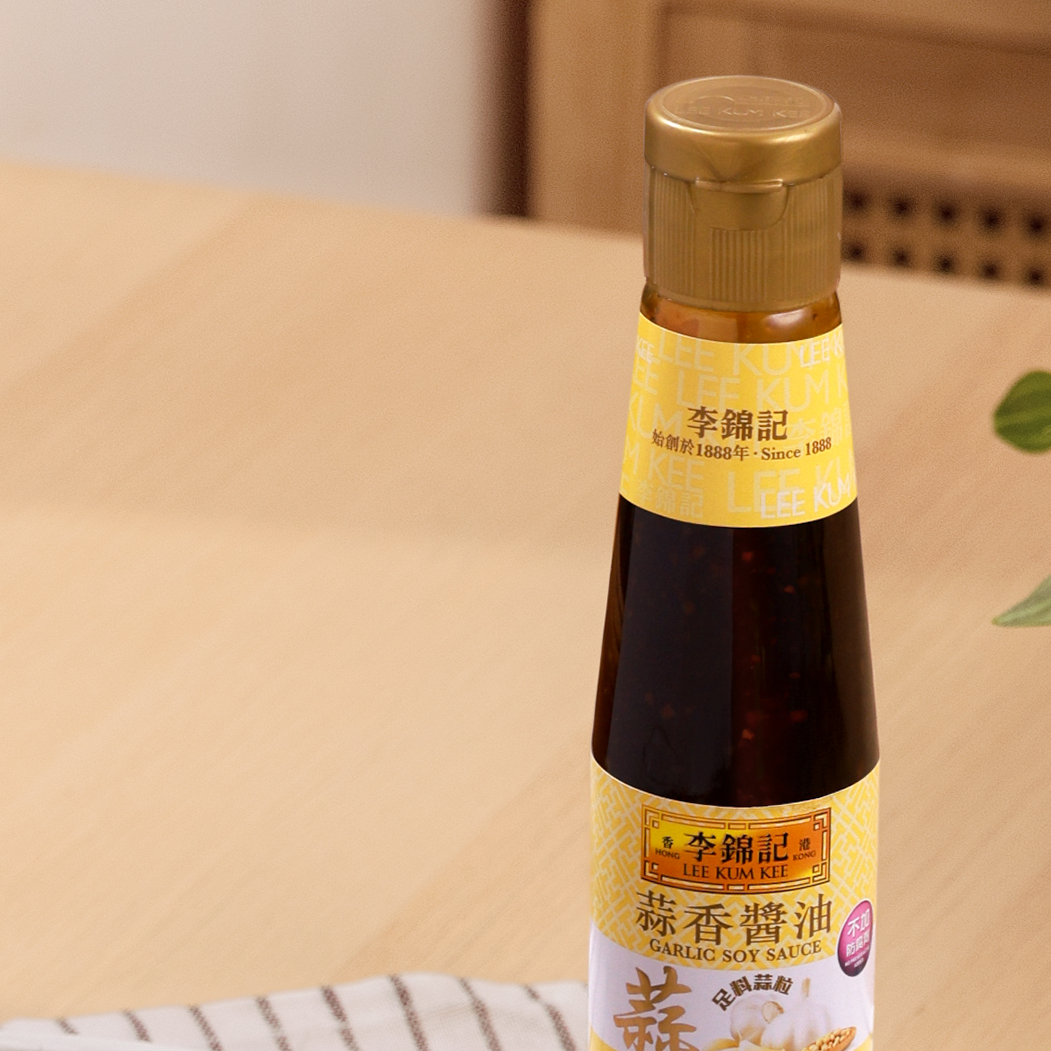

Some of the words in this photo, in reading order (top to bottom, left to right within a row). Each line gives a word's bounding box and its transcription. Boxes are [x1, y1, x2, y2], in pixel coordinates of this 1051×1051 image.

[718, 106, 764, 117] KUM
[756, 369, 830, 413] KUM
[686, 405, 789, 442] 李錦記
[761, 446, 801, 461] Since
[804, 437, 832, 455] 1888
[649, 448, 705, 493] KEE
[760, 488, 806, 520] LEE
[655, 848, 681, 860] HONG
[792, 850, 816, 861] KONG
[661, 836, 674, 848] 香
[683, 831, 788, 865] 李錦記
[799, 838, 810, 851] 港
[683, 863, 709, 877] LEE
[716, 866, 754, 880] KUM
[760, 864, 788, 879] KEE
[635, 889, 832, 946] 蒜香醬油
[649, 938, 716, 962] GARLIC
[722, 949, 760, 963] SOY
[766, 939, 822, 962] SAUCE
[711, 973, 794, 1011] 足料蒜粒
